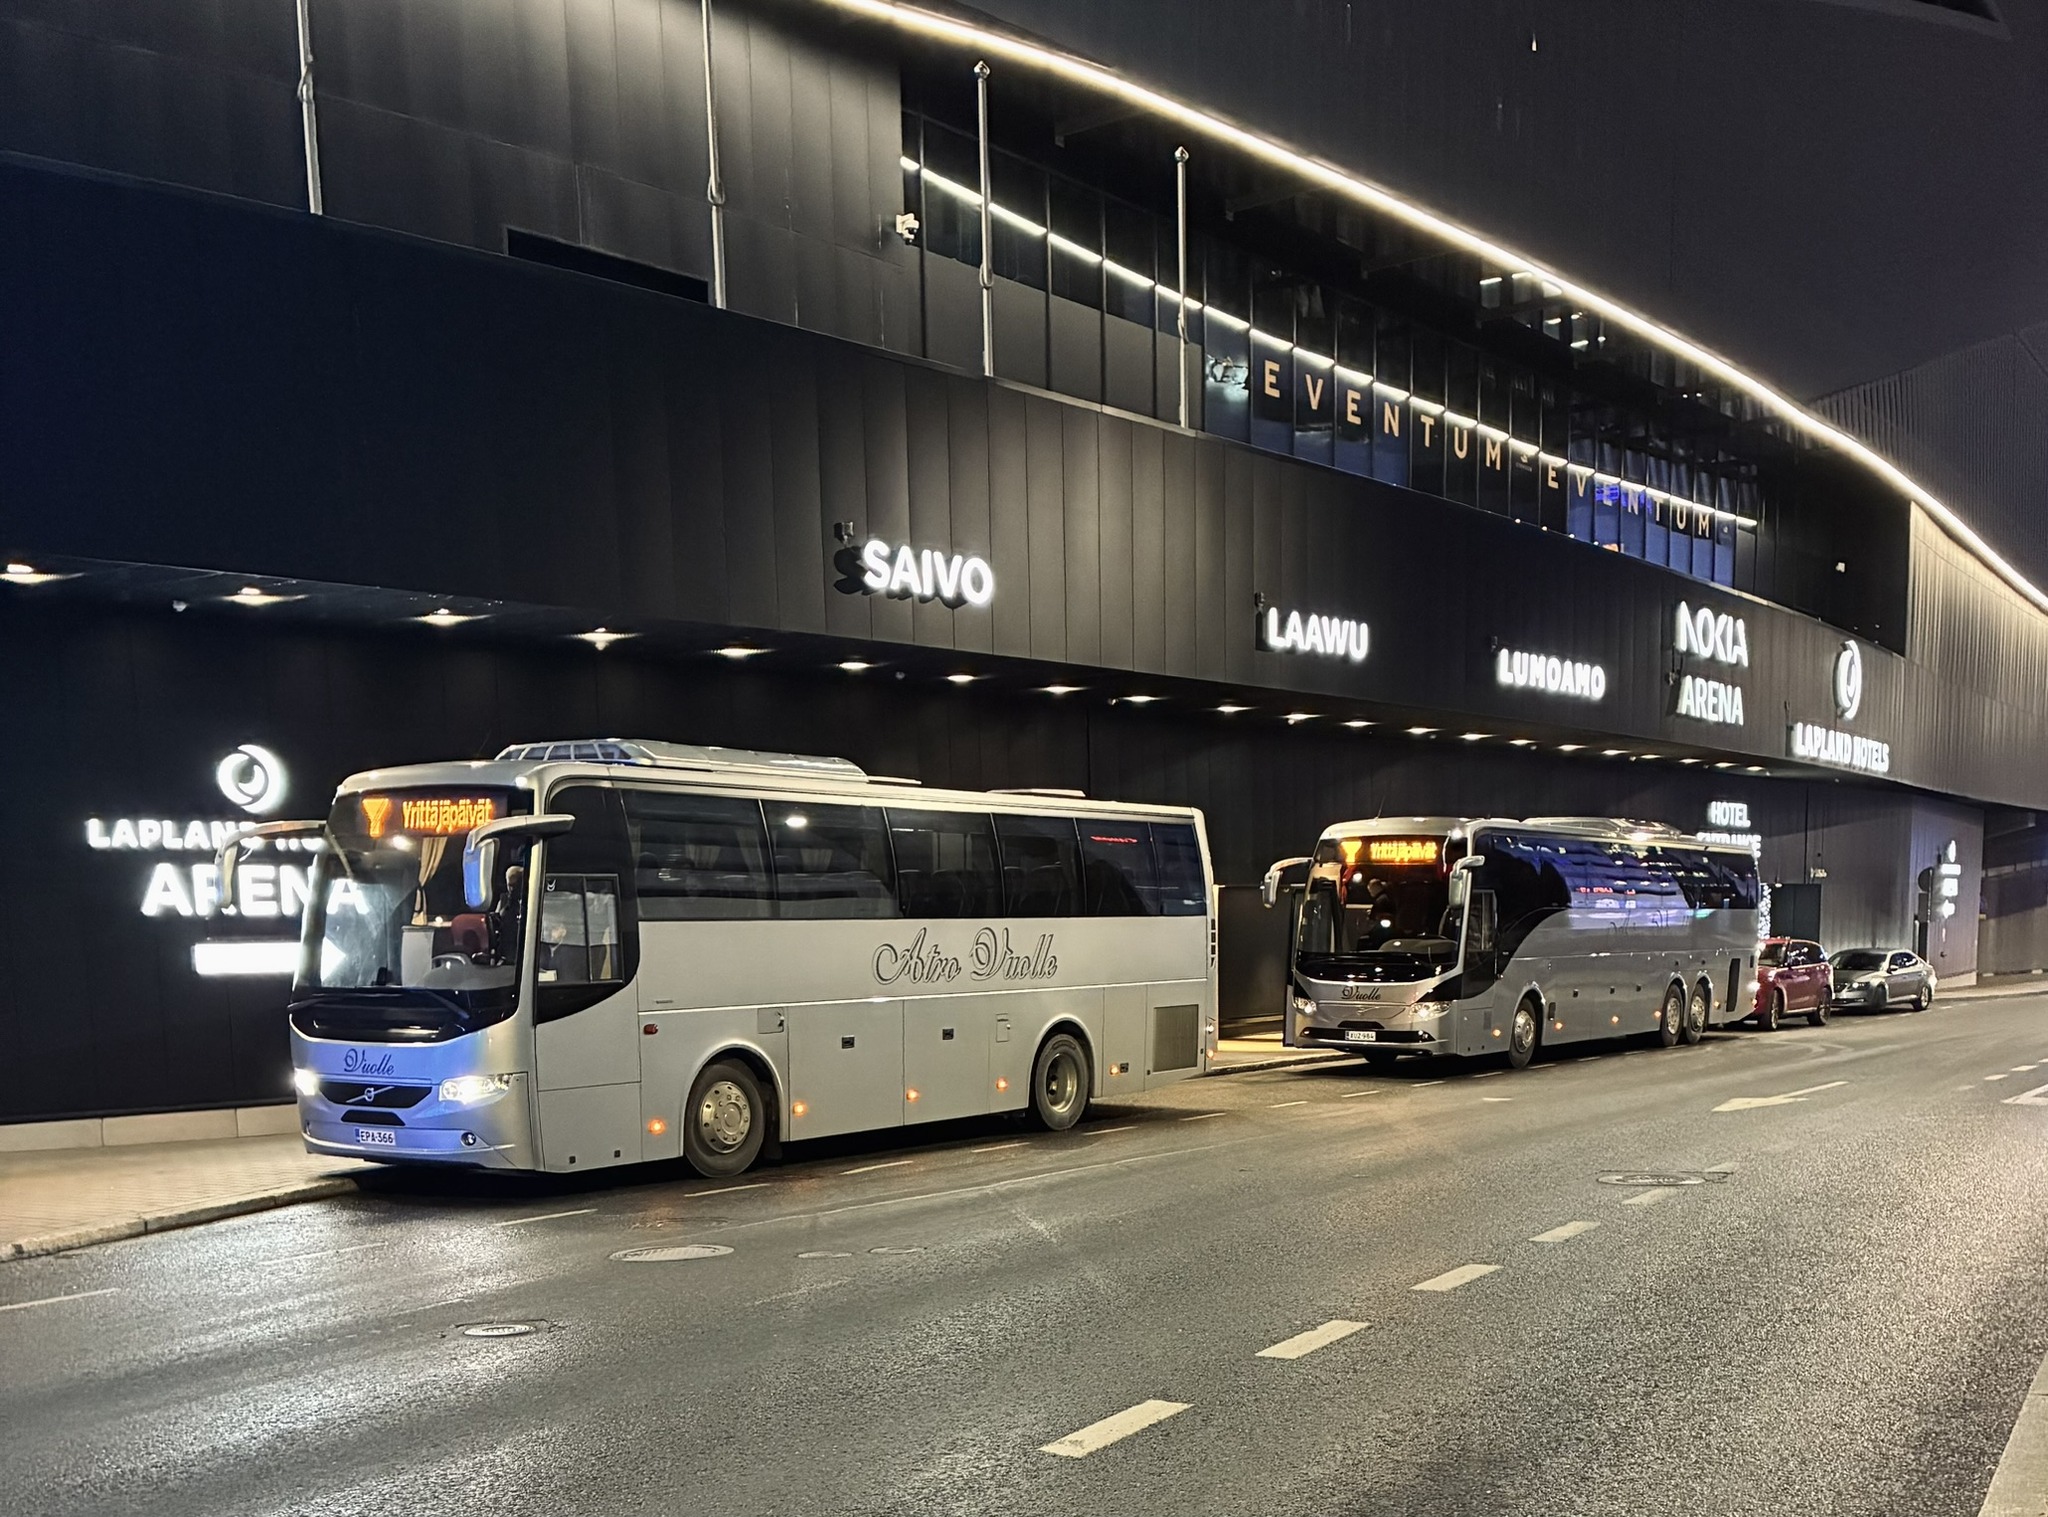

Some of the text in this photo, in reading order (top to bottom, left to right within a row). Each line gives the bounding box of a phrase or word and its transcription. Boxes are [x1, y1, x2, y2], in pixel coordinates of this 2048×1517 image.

[1264, 360, 1501, 470] EVENTUM
[1547, 461, 1711, 538] EVENTUM
[862, 539, 994, 605] SAIVO
[1266, 607, 1369, 660] LAAWU
[1676, 600, 1748, 668] NOKIA
[1499, 648, 1606, 700] LUMOAMO
[1677, 674, 1744, 726] ARENA
[1794, 721, 1890, 773] LAPLAND HOTELS
[402, 798, 492, 834] Yrittäjäpäivät
[1709, 801, 1752, 828] HOTEL
[872, 926, 1058, 985] Atro Vuolle
[1341, 985, 1381, 1000] Vuolle
[344, 1048, 395, 1076] Vuolle
[360, 1130, 394, 1144] EPA-366
